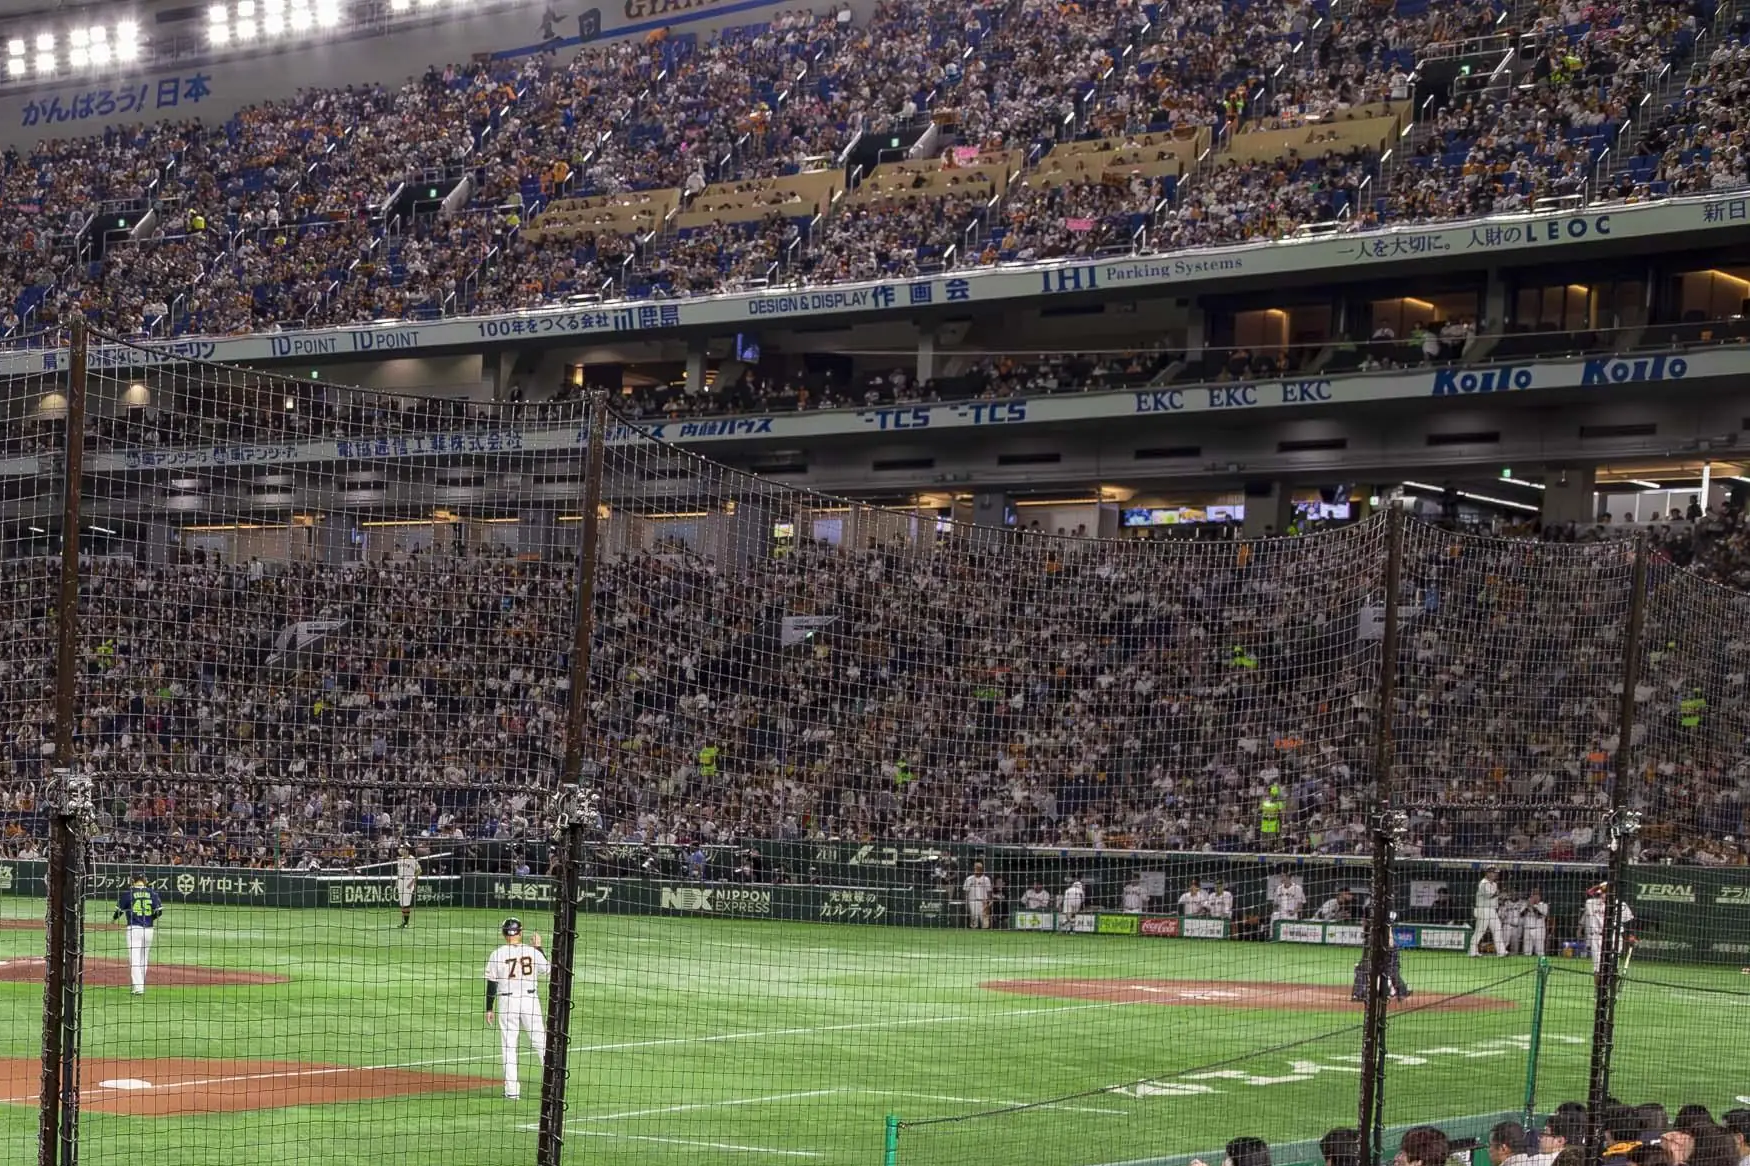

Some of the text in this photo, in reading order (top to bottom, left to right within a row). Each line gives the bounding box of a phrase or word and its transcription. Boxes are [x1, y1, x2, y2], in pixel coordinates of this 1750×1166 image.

[156, 73, 212, 109] 日本
[1525, 215, 1611, 243] LEOC
[1041, 256, 1243, 293] IHI Parking Systems
[749, 301, 799, 315] DESIGN
[811, 291, 869, 311] DISPLAY
[871, 279, 971, 307] 作画会
[478, 310, 611, 338] 100年をつくる会社
[44, 346, 140, 370] 肩・の痛みに
[1135, 381, 1332, 413] EKC EKC EKC
[199, 877, 265, 896] 竹中土木
[345, 886, 401, 902] DAZN.CO
[506, 883, 614, 903] 長谷工ループ
[716, 890, 771, 902] NIPPON
[1637, 883, 1695, 896] TERAL
[133, 899, 152, 915] 45
[715, 900, 771, 913] EXPRESS
[505, 956, 533, 978] 78
